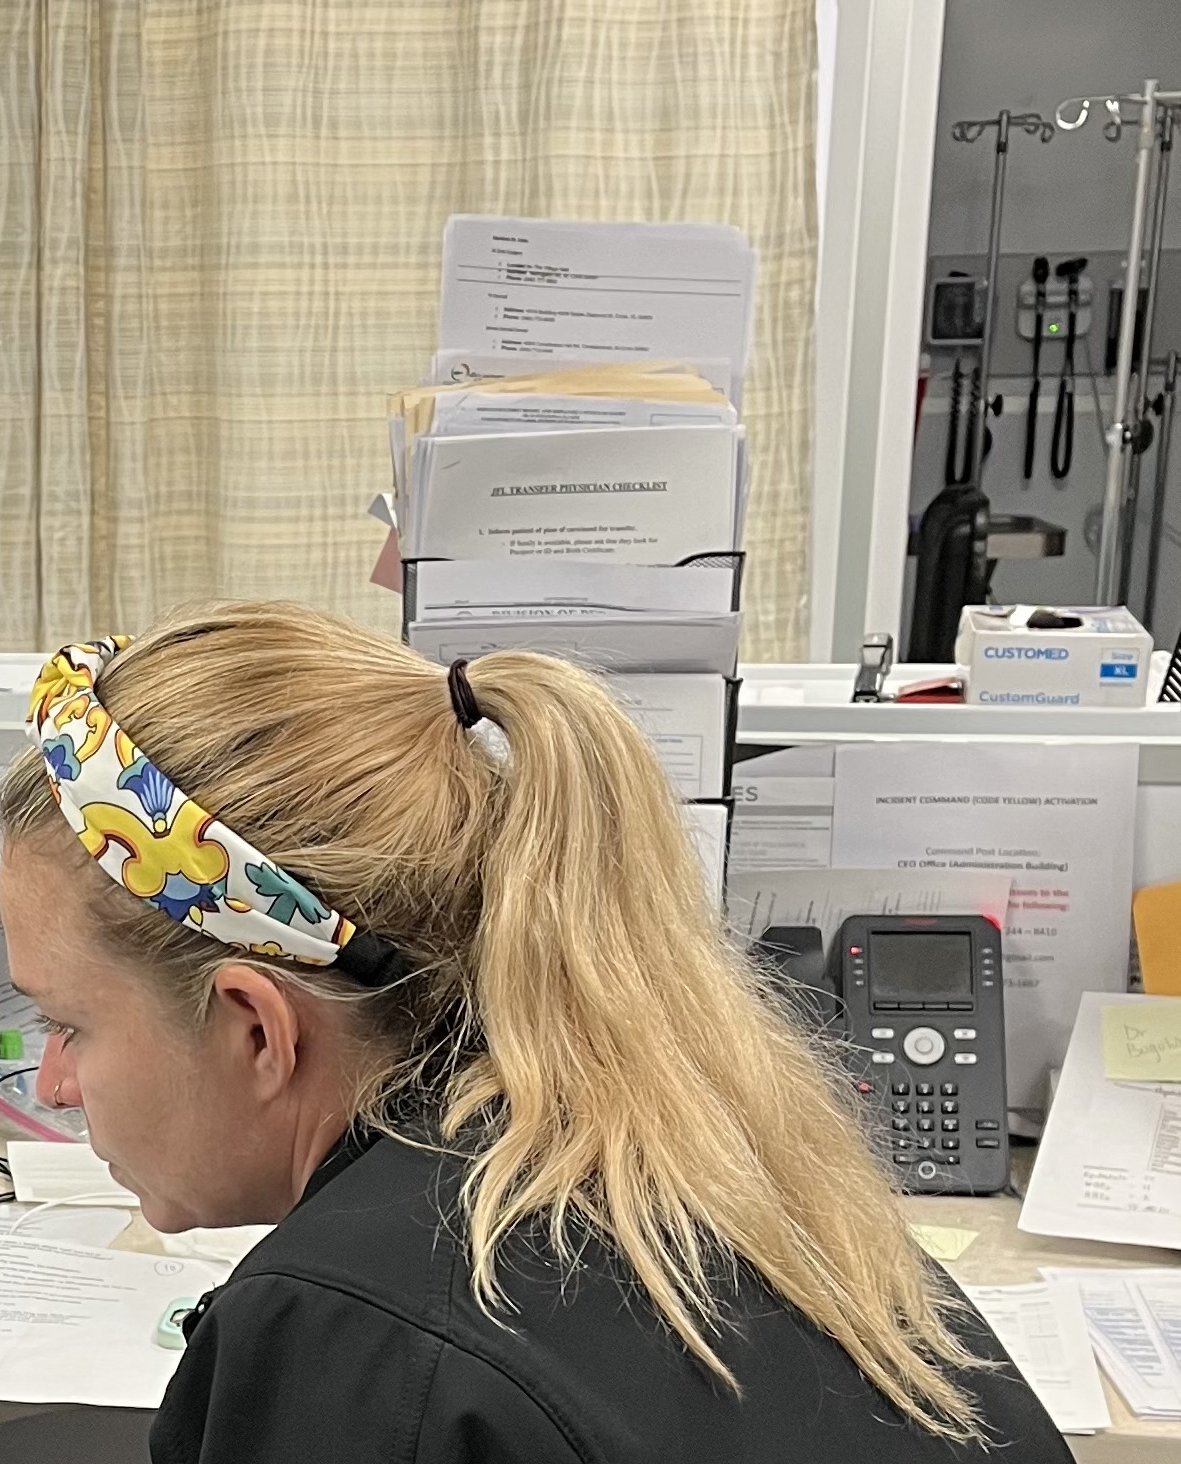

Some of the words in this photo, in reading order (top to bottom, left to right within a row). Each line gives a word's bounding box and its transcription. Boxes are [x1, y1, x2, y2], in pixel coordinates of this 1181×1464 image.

[509, 485, 557, 496] TRANSFER
[612, 481, 667, 493] CHECKLIST
[984, 647, 1069, 660] CUSTOMED
[1113, 665, 1130, 676] XL
[979, 690, 1080, 705] CustomGuard
